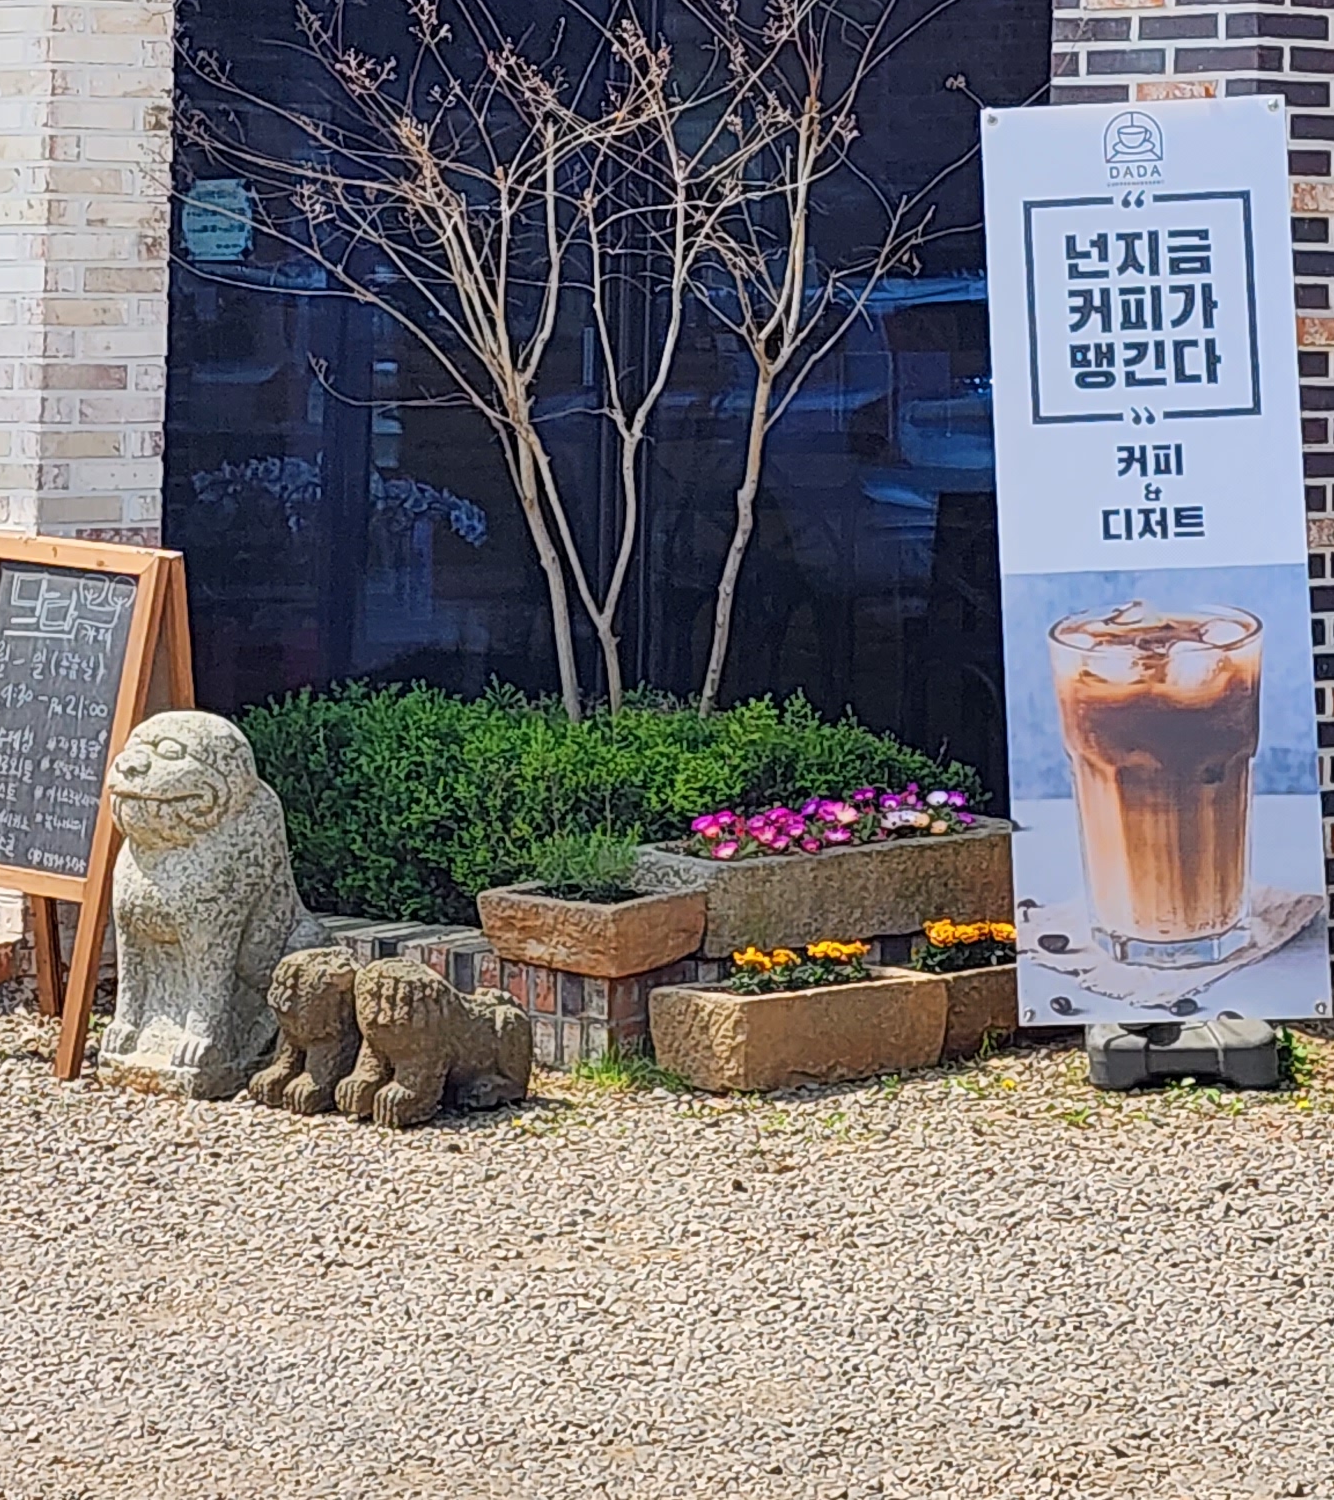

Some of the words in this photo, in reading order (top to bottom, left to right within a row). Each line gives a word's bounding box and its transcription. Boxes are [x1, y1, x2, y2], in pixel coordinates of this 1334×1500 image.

[1109, 164, 1162, 179] DADA
[1065, 227, 1213, 280] 넌지금
[1067, 282, 1219, 334] 커피가
[1069, 337, 1222, 390] 땡긴다
[1116, 443, 1184, 478] 커피
[1101, 505, 1206, 542] 디저트
